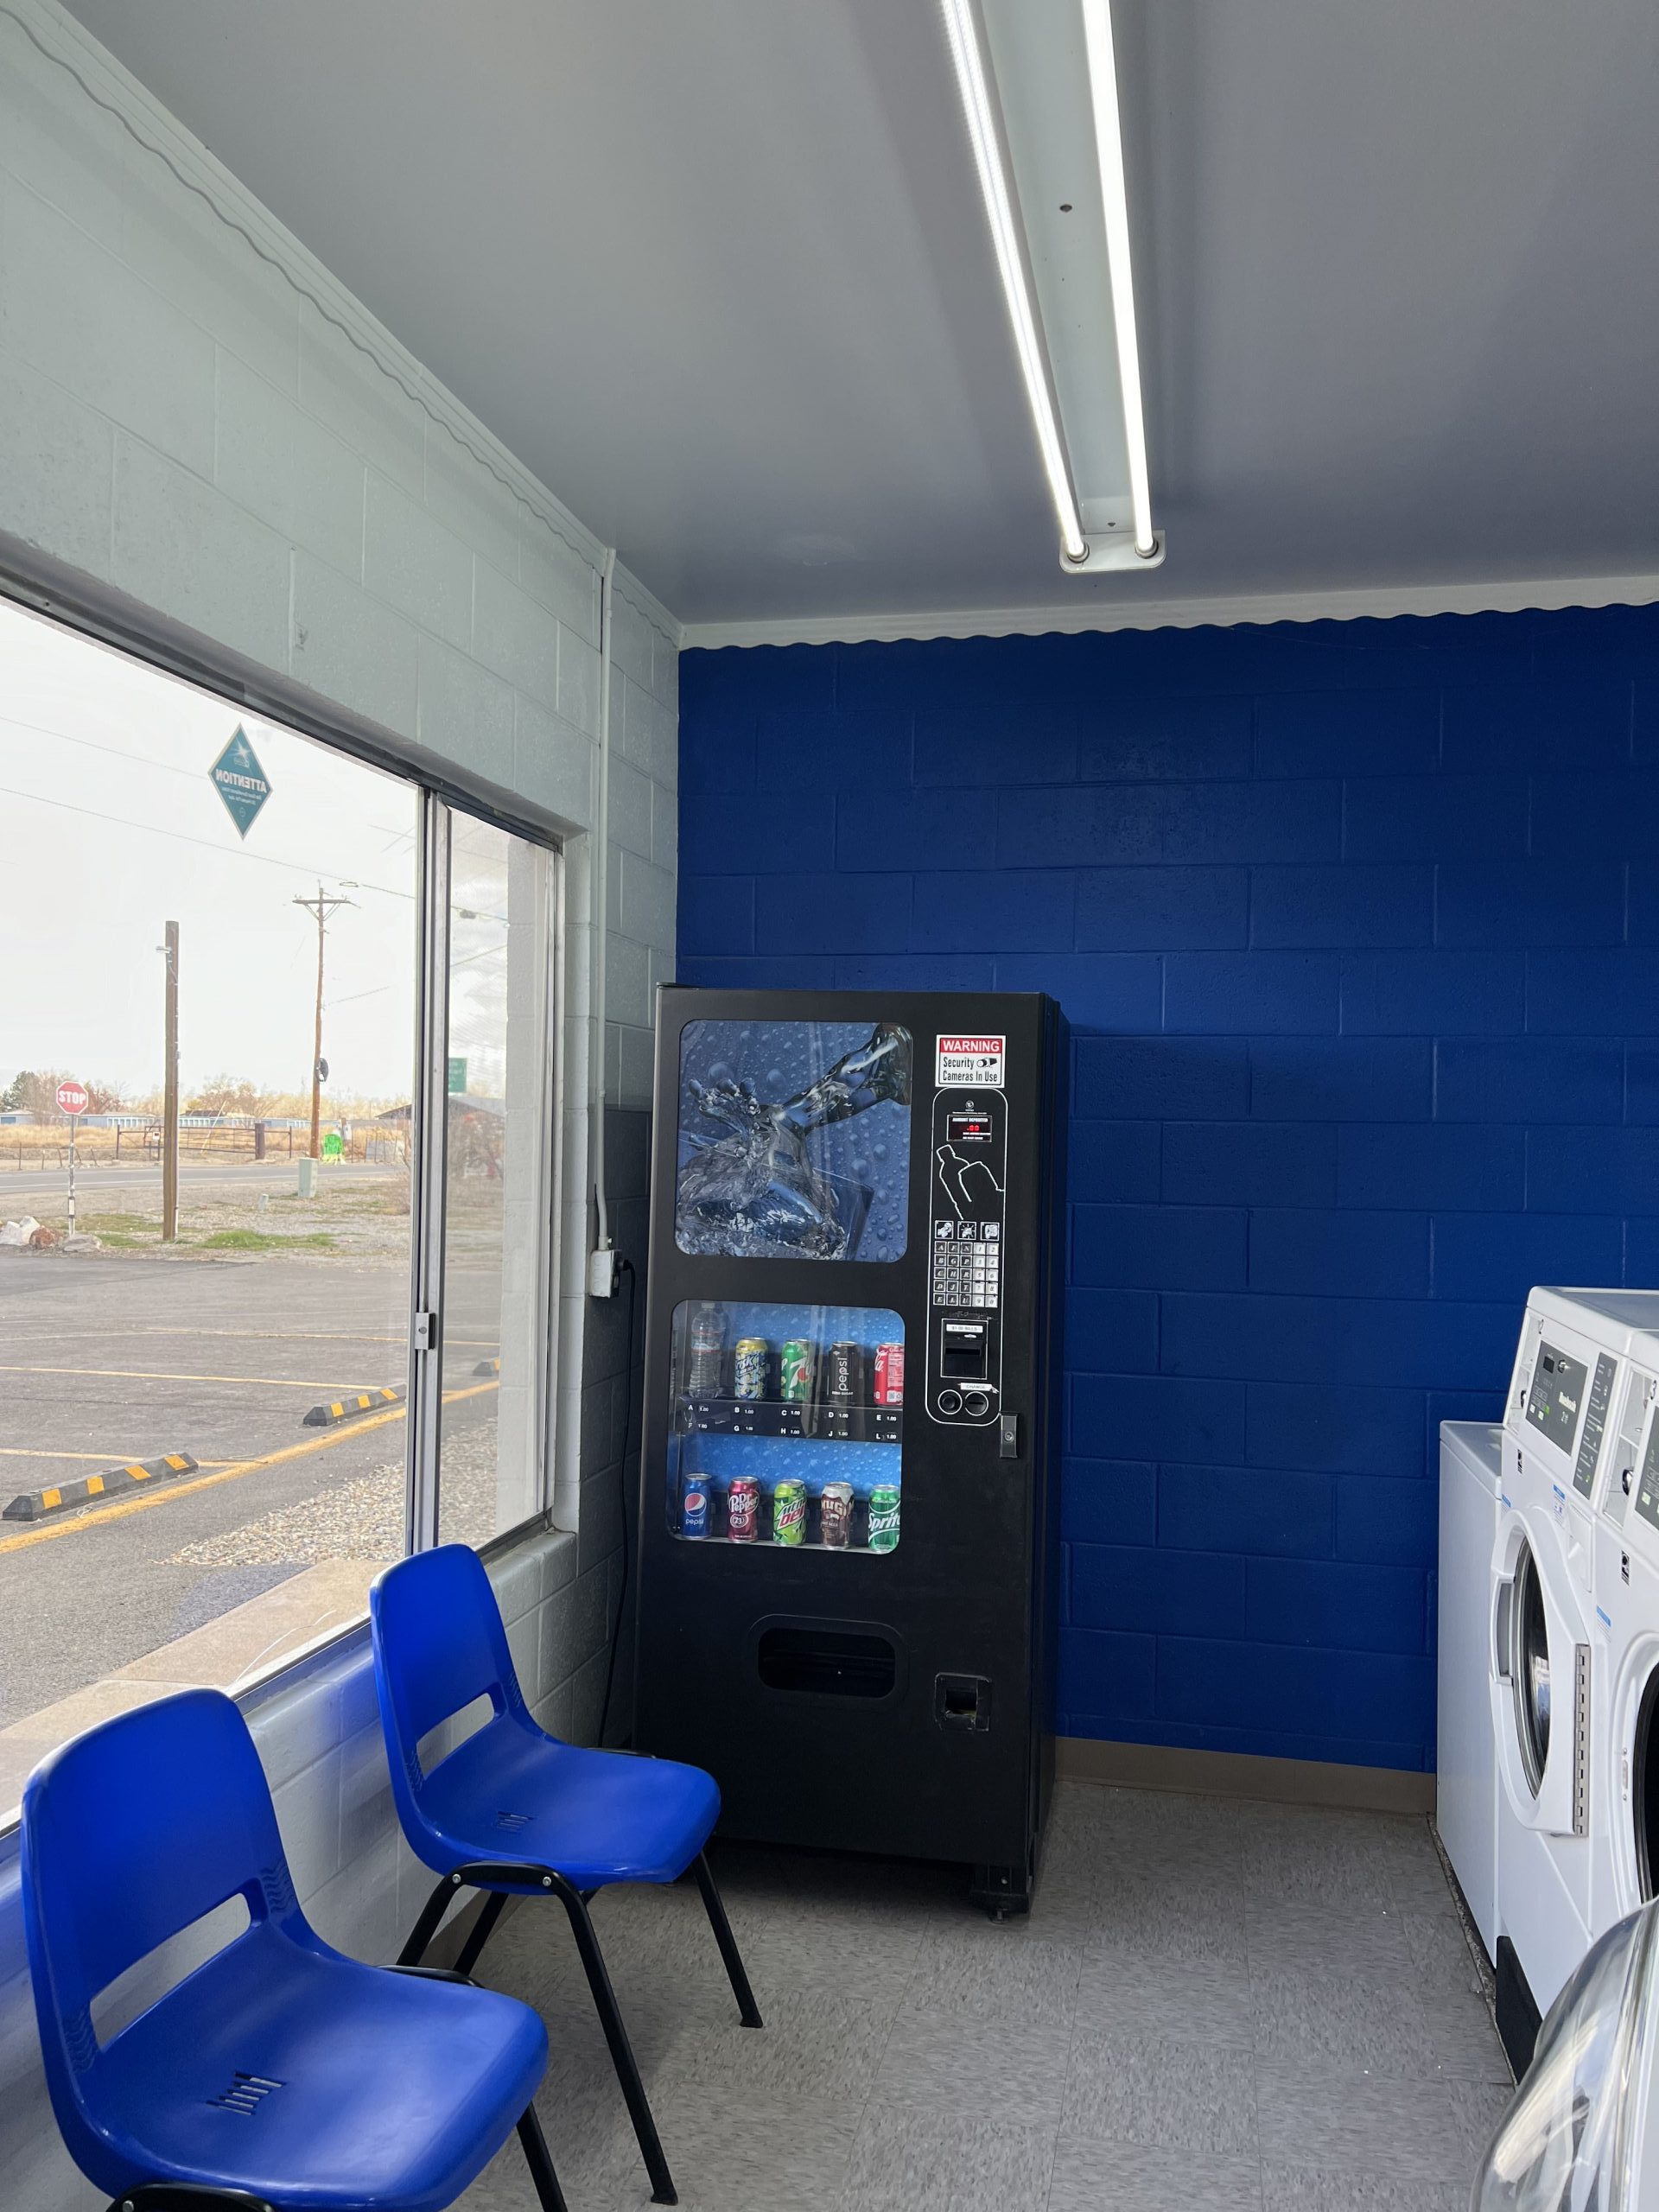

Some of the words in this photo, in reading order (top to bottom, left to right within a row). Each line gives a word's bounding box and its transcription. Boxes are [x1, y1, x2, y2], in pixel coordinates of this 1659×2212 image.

[943, 1040, 1000, 1052] WARNING
[943, 1056, 975, 1070] Security
[943, 1071, 974, 1081] Cameras
[976, 1071, 982, 1081] In
[985, 1071, 998, 1082] Use
[59, 1090, 86, 1104] STOP
[836, 1357, 849, 1391] pepsi
[1650, 1380, 1657, 1400] 3
[728, 1495, 758, 1513] Pepper
[740, 1493, 753, 1503] Dr
